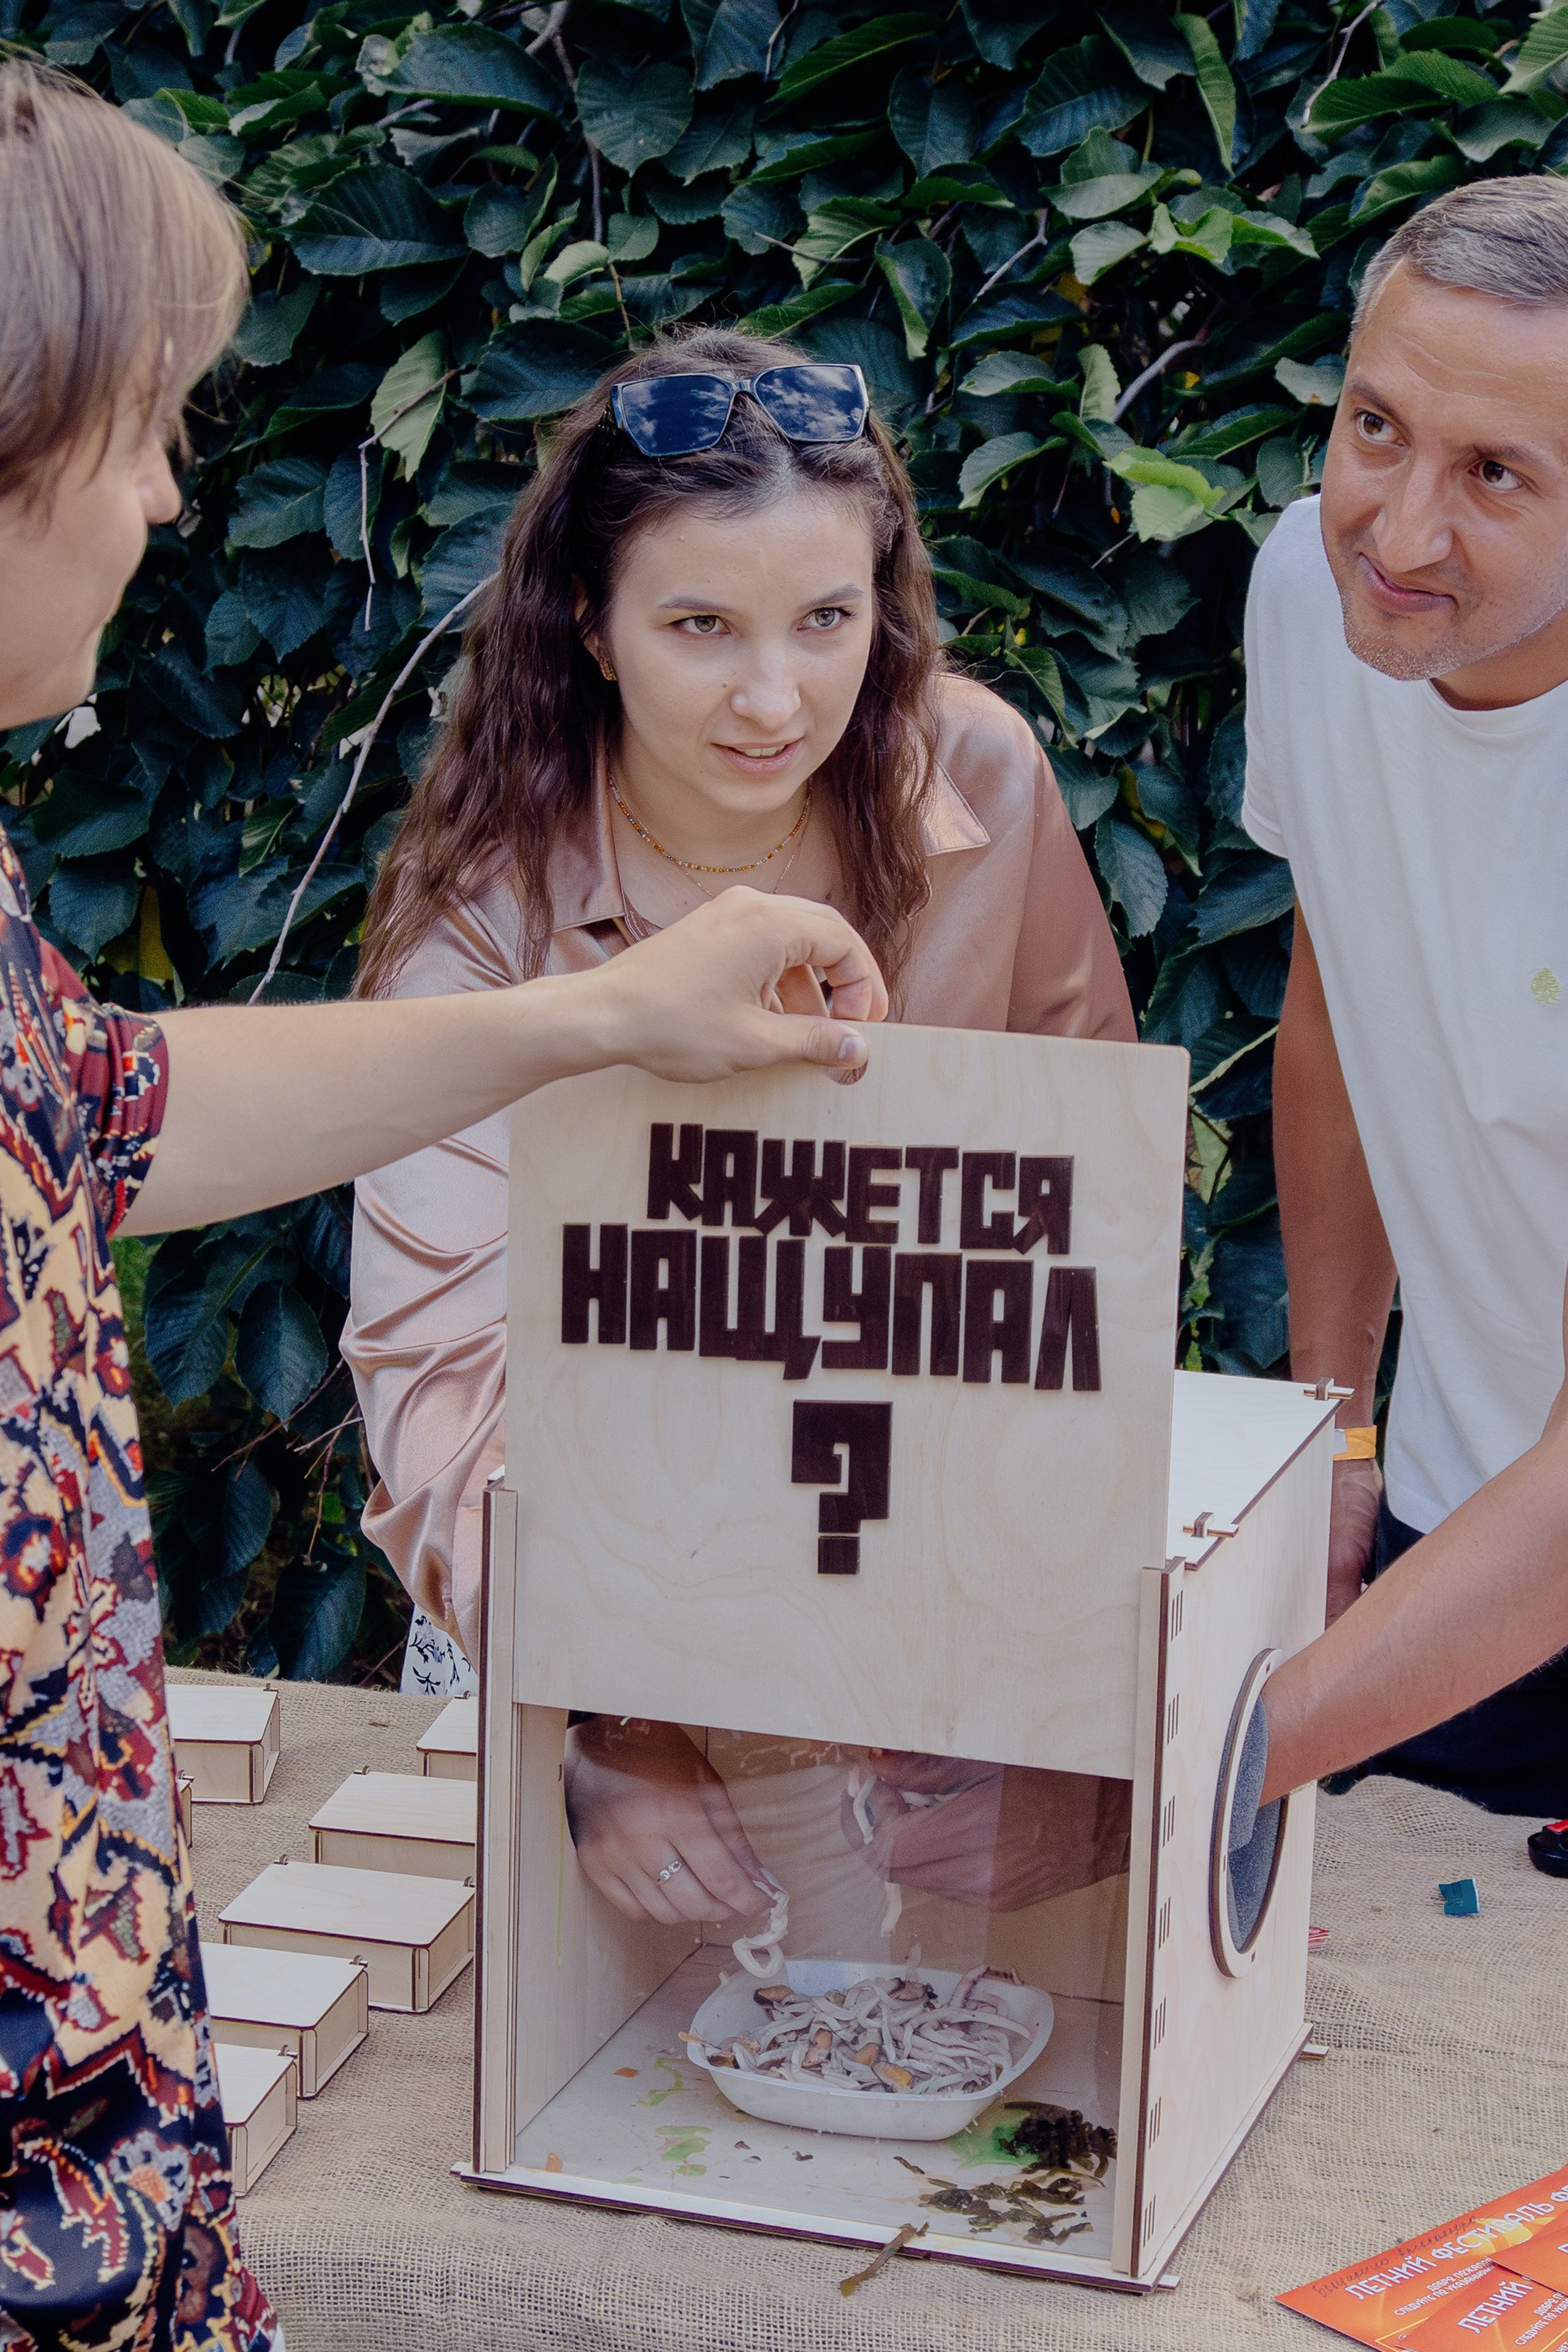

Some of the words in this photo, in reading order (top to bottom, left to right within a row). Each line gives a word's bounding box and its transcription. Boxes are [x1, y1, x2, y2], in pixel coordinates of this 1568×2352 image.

[646, 1122, 1075, 1255] КАЖЕТСЯ
[561, 1222, 1102, 1392] НАЩУПАЛ
[791, 1400, 894, 1575] ?
[1344, 2255, 1438, 2301] ЛЕТНИЙ
[1431, 2203, 1555, 2260] ФЕСТИВАЛЬ
[1393, 2294, 1437, 2316] СЛЕДУЙТЕ
[1432, 2288, 1449, 2298] ПО
[1426, 2275, 1457, 2292] ДОБРО
[1457, 2280, 1534, 2334] ЛЕТНИЙ
[1533, 2298, 1559, 2316] ДОБРО
[1514, 2320, 1549, 2345] СЛЕДУЙТЕ
[1542, 2312, 1558, 2321] ПО
